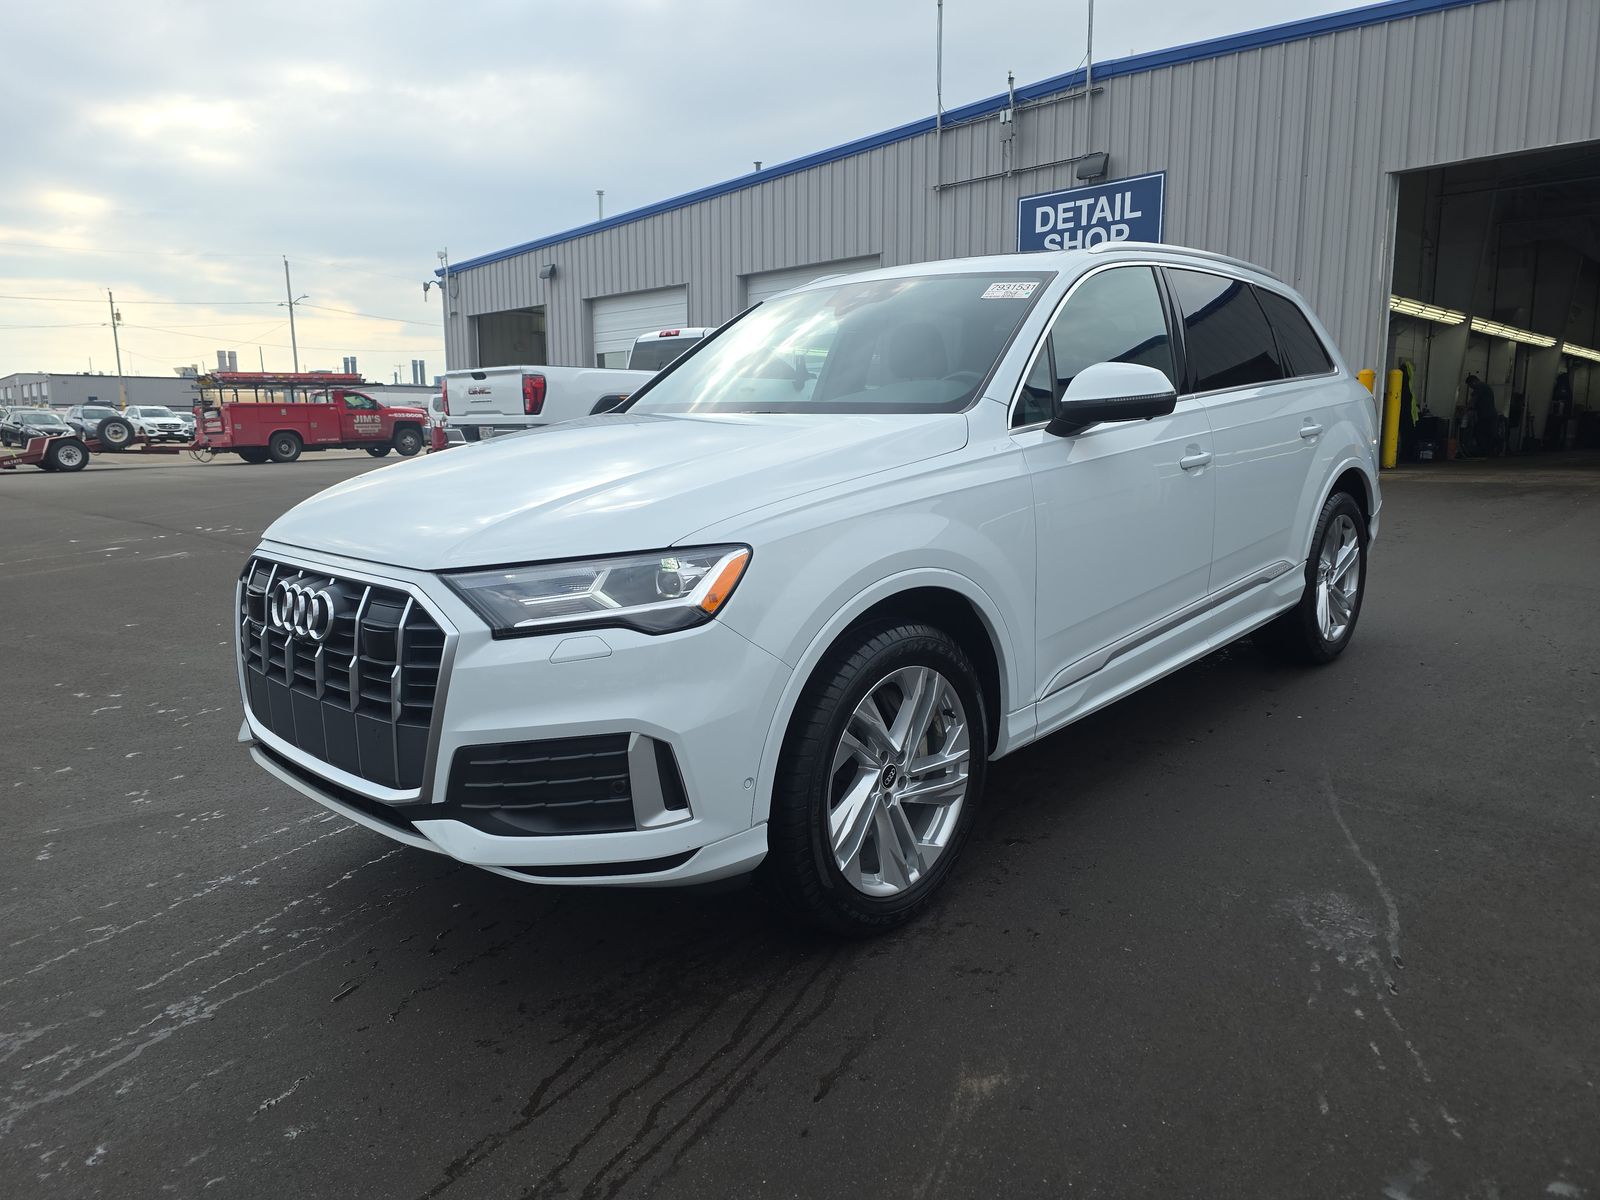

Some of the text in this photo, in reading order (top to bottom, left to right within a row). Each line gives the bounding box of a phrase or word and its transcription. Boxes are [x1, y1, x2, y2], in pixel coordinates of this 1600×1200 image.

[1035, 191, 1142, 233] DETAIL
[1043, 223, 1130, 250] SHOP
[353, 415, 381, 423] JIM'S
